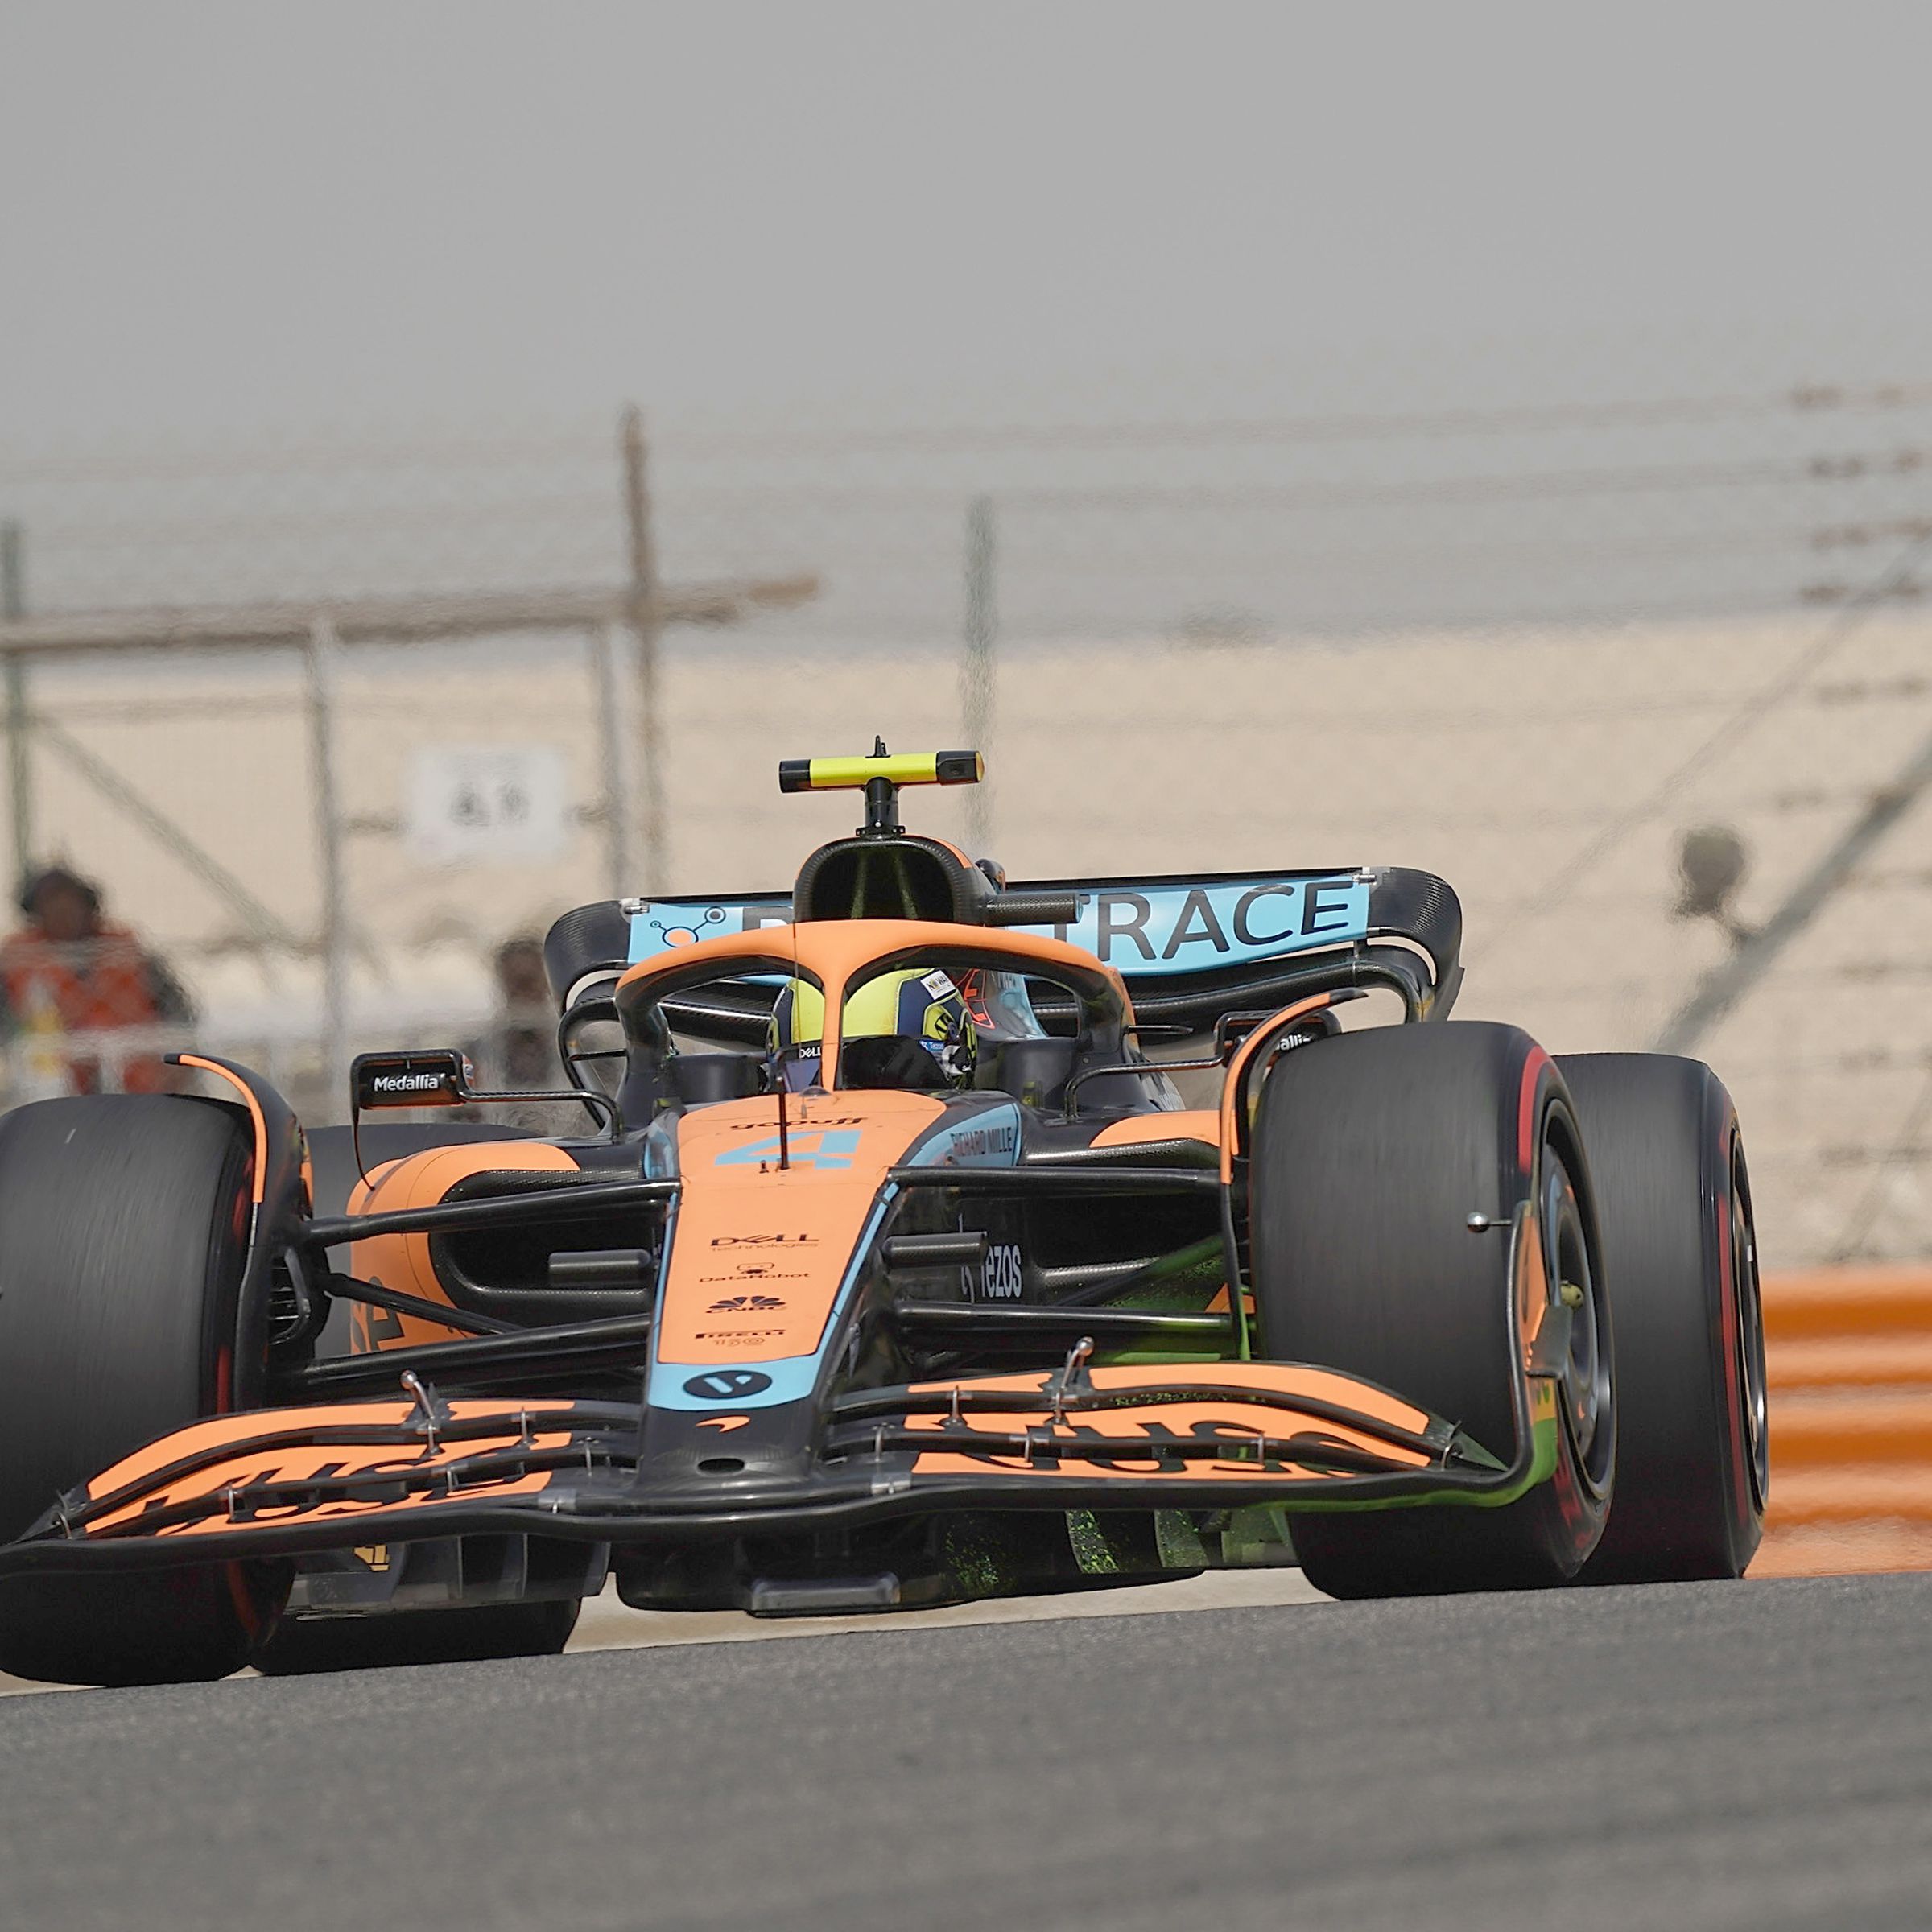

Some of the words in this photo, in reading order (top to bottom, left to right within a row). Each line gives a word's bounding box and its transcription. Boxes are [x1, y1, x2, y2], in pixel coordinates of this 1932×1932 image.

[374, 1074, 439, 1092] Medallia
[987, 1127, 1013, 1154] MILLE
[714, 1130, 863, 1170] 4
[711, 1234, 819, 1247] DELL
[699, 1273, 811, 1283] DataRobot
